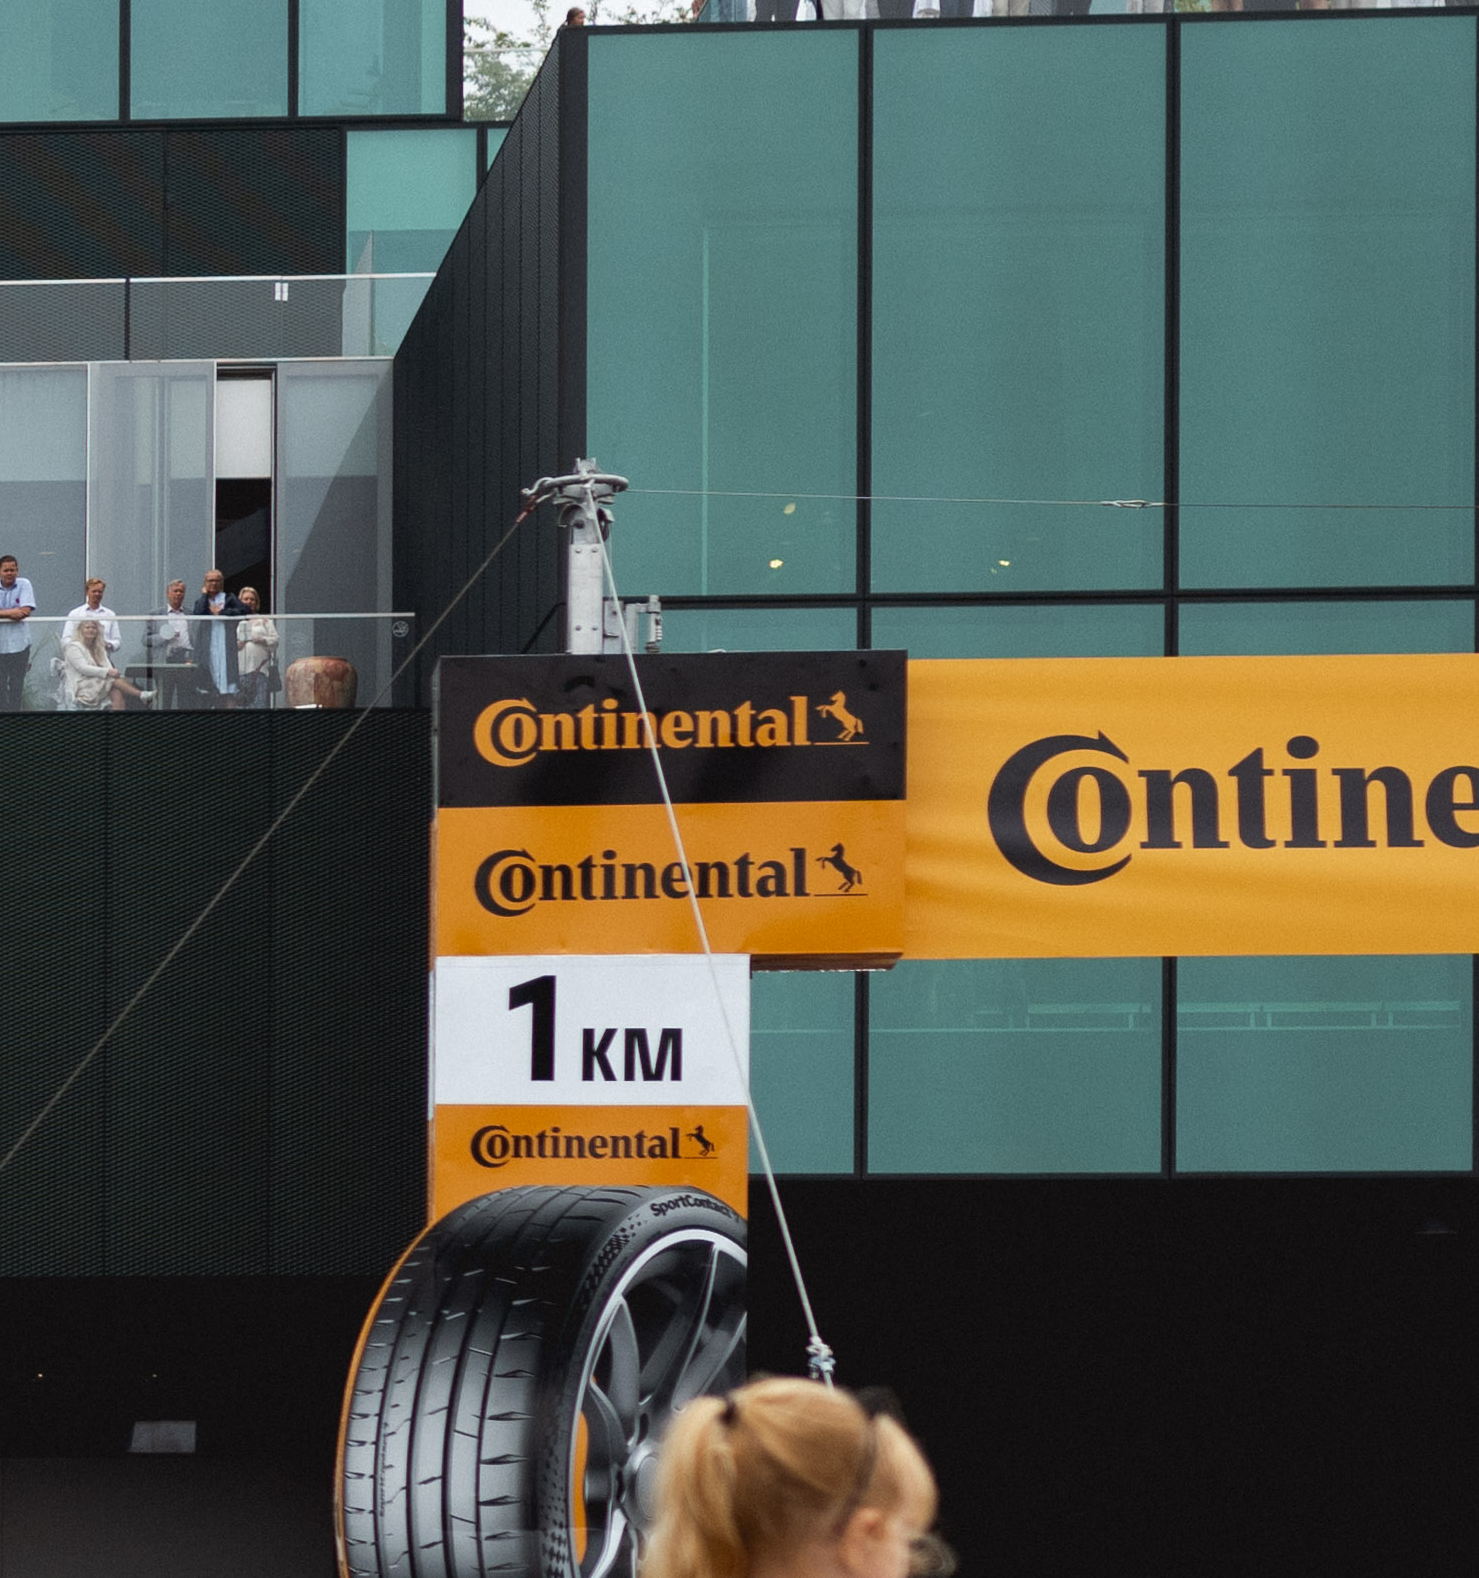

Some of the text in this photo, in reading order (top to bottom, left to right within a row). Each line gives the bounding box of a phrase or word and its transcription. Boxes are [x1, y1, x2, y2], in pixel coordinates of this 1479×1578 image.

[473, 695, 812, 768] Continental
[987, 729, 1479, 886] Contine
[474, 847, 811, 918] Continental
[508, 974, 683, 1082] 1 KM
[470, 1124, 683, 1169] Continental
